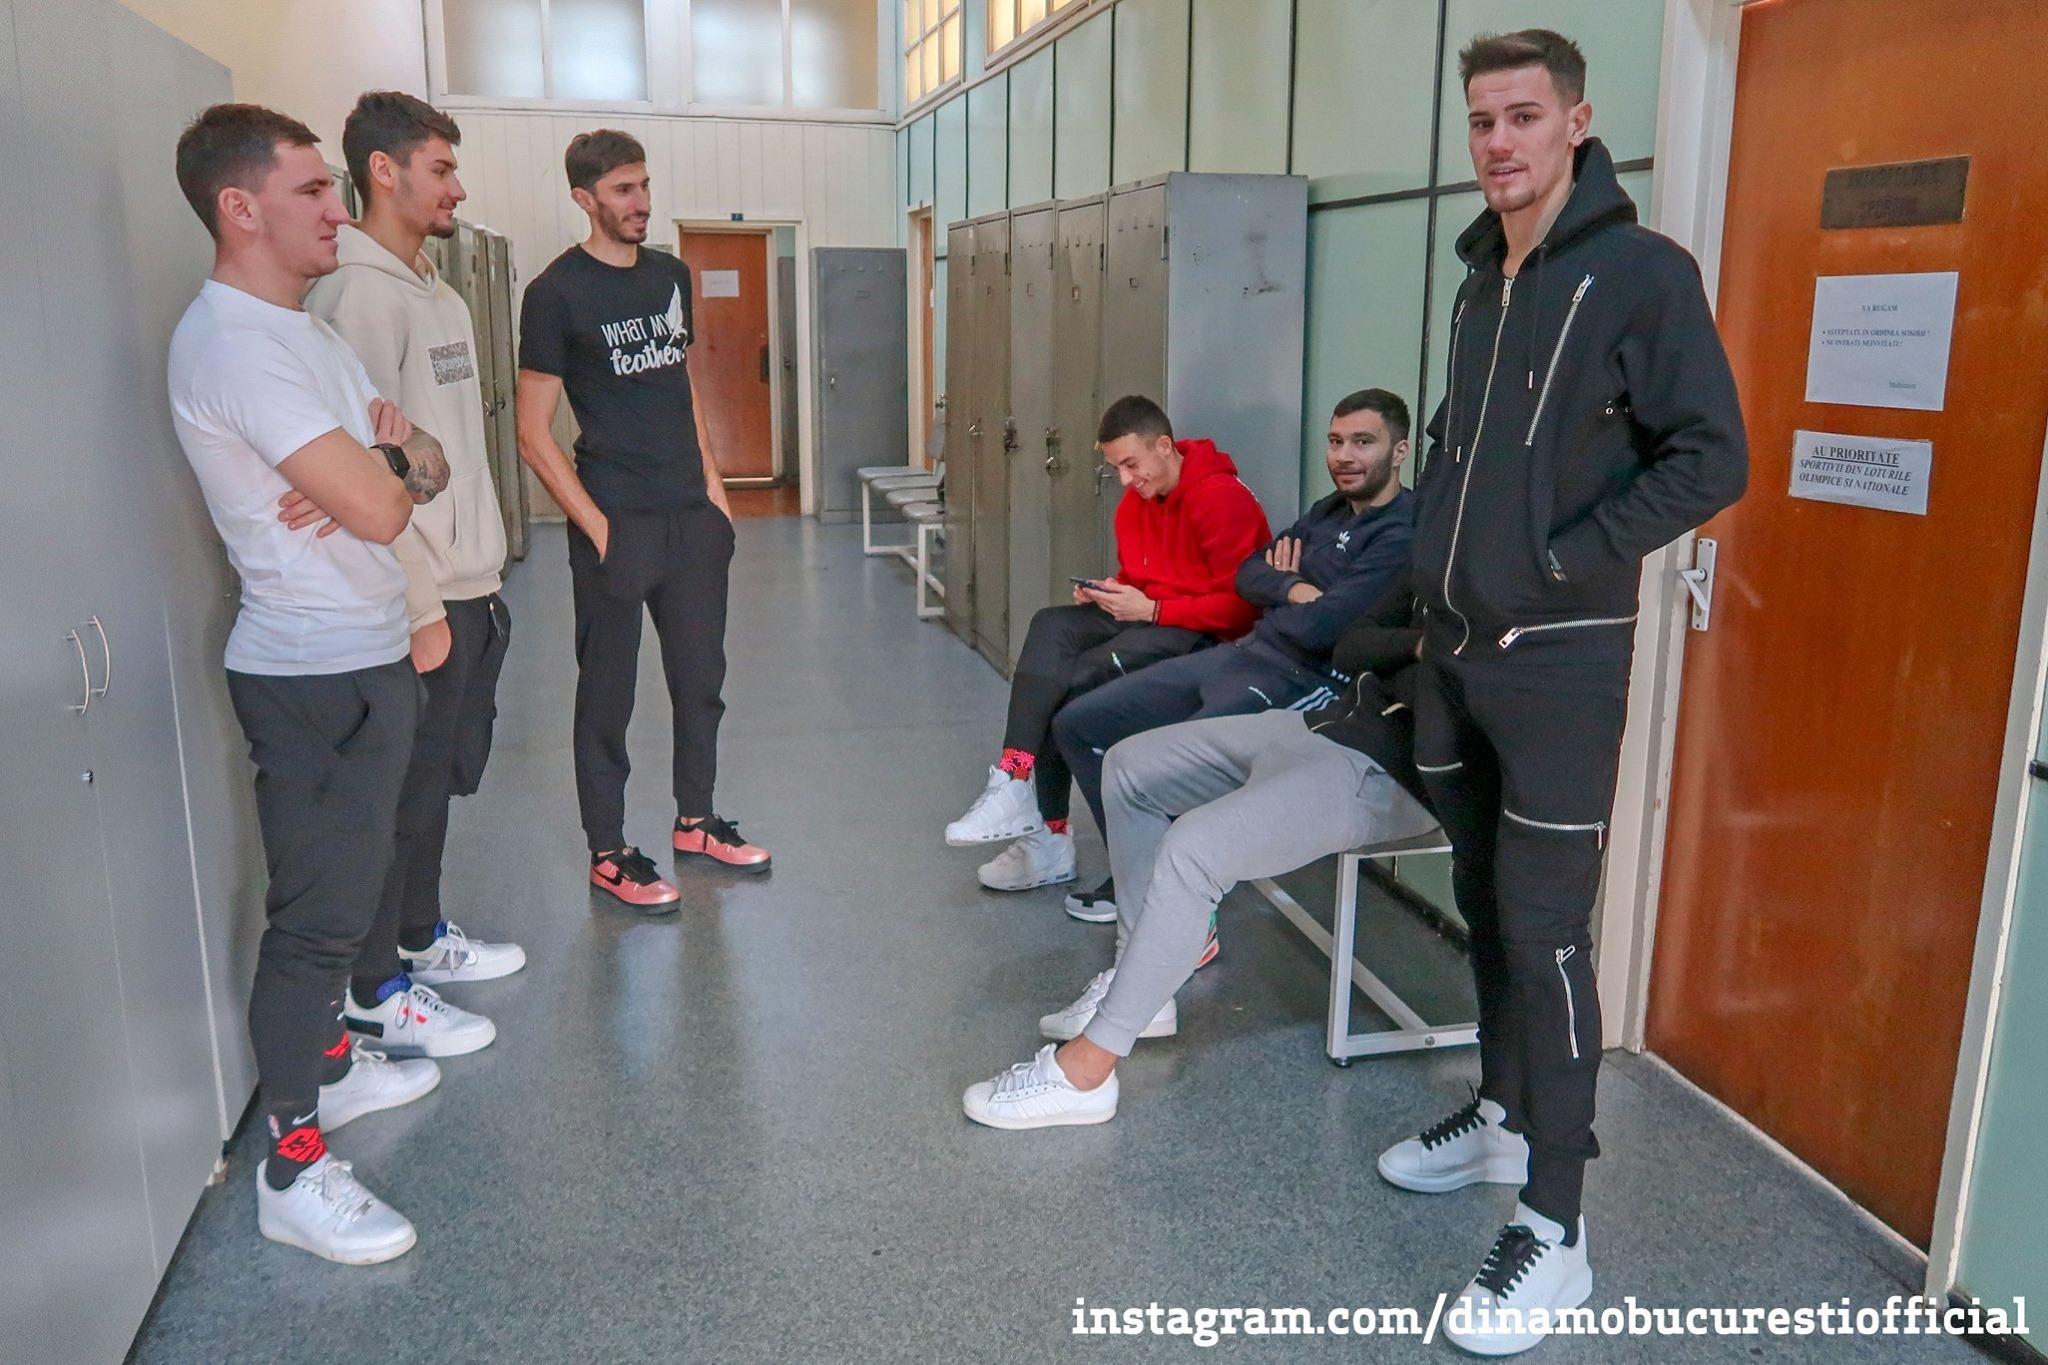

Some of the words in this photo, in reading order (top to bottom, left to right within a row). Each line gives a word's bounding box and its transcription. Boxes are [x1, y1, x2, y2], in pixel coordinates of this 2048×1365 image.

[649, 312, 674, 338] MY
[1812, 445, 1828, 457] AU
[1830, 446, 1900, 465] PRIORITATE
[1799, 472, 1842, 486] OLIMPICE
[1800, 459, 1843, 473] SPORTIVII
[1845, 464, 1862, 474] DIN
[1864, 466, 1912, 481] LOTURILE
